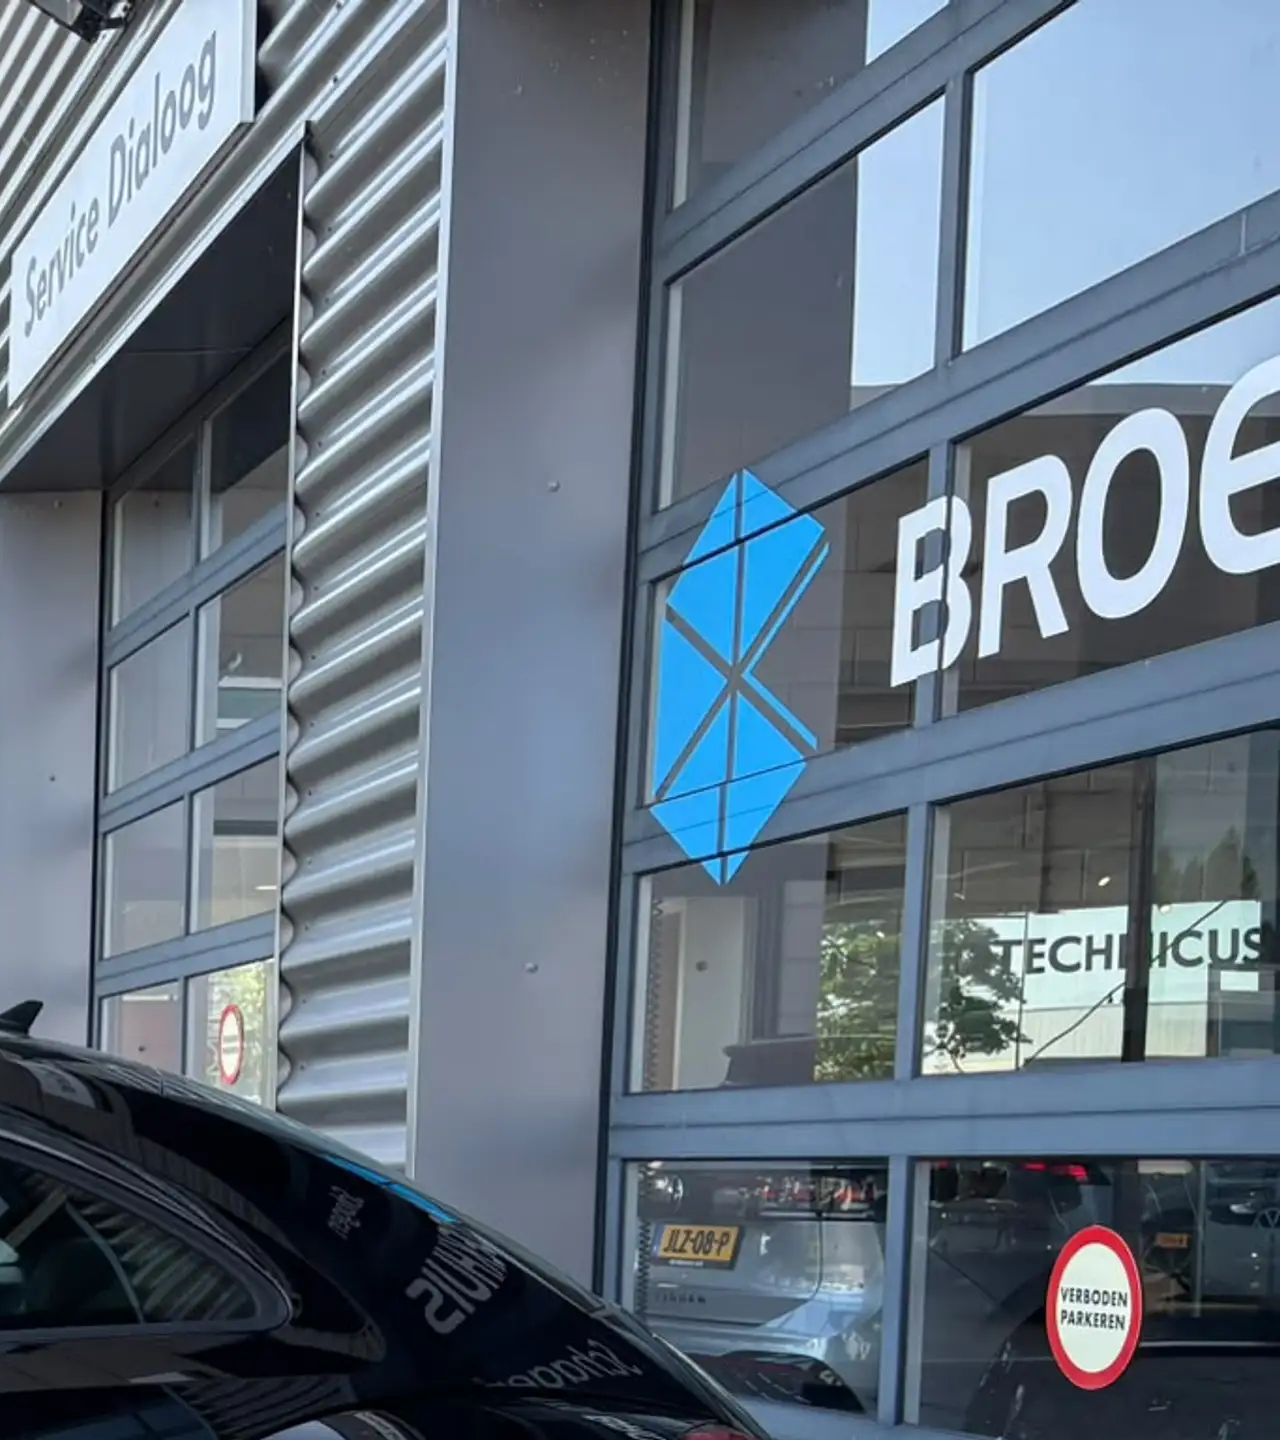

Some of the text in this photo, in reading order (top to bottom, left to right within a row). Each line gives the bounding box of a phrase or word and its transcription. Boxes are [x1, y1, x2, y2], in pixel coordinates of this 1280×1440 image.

[25, 30, 217, 338] Service Dialoog
[1060, 1287, 1128, 1309] VERBODEN
[1060, 1309, 1126, 1331] PARKEREN
